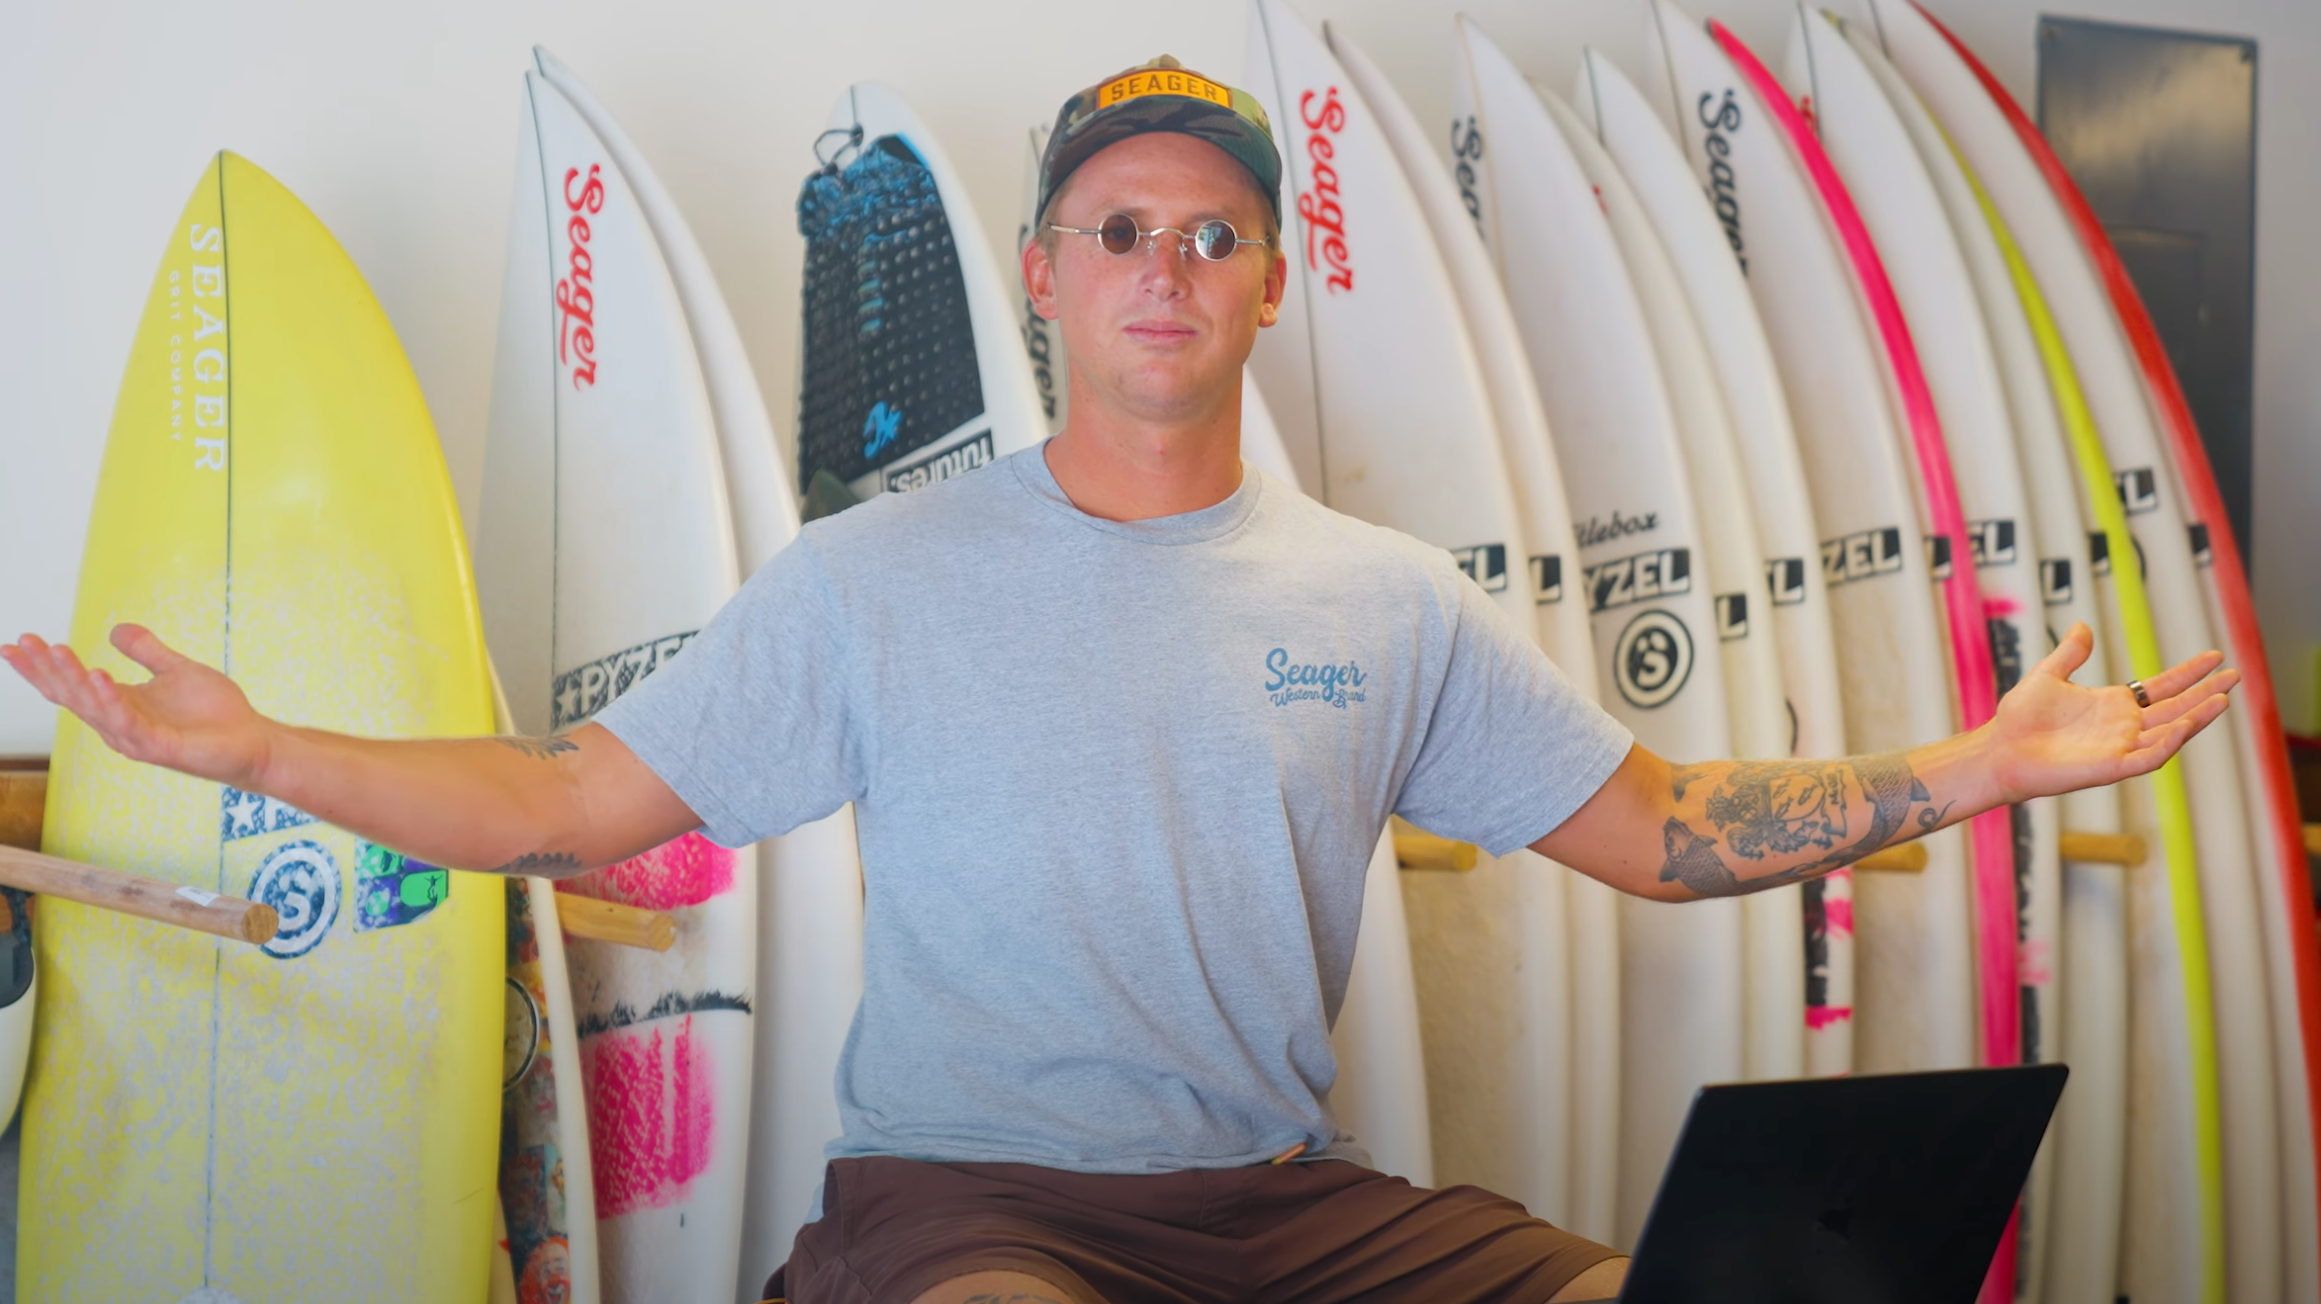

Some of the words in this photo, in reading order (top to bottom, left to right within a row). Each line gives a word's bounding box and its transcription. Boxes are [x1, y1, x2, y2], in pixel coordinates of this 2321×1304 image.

[1111, 74, 1218, 101] SEAGER
[1298, 86, 1354, 295] Seager
[169, 270, 182, 321] GRIT
[556, 163, 604, 392] Seager
[170, 334, 183, 442] COMPANY
[190, 223, 226, 472] SEAGER
[1265, 647, 1368, 702] Seager
[1270, 687, 1320, 707] Western
